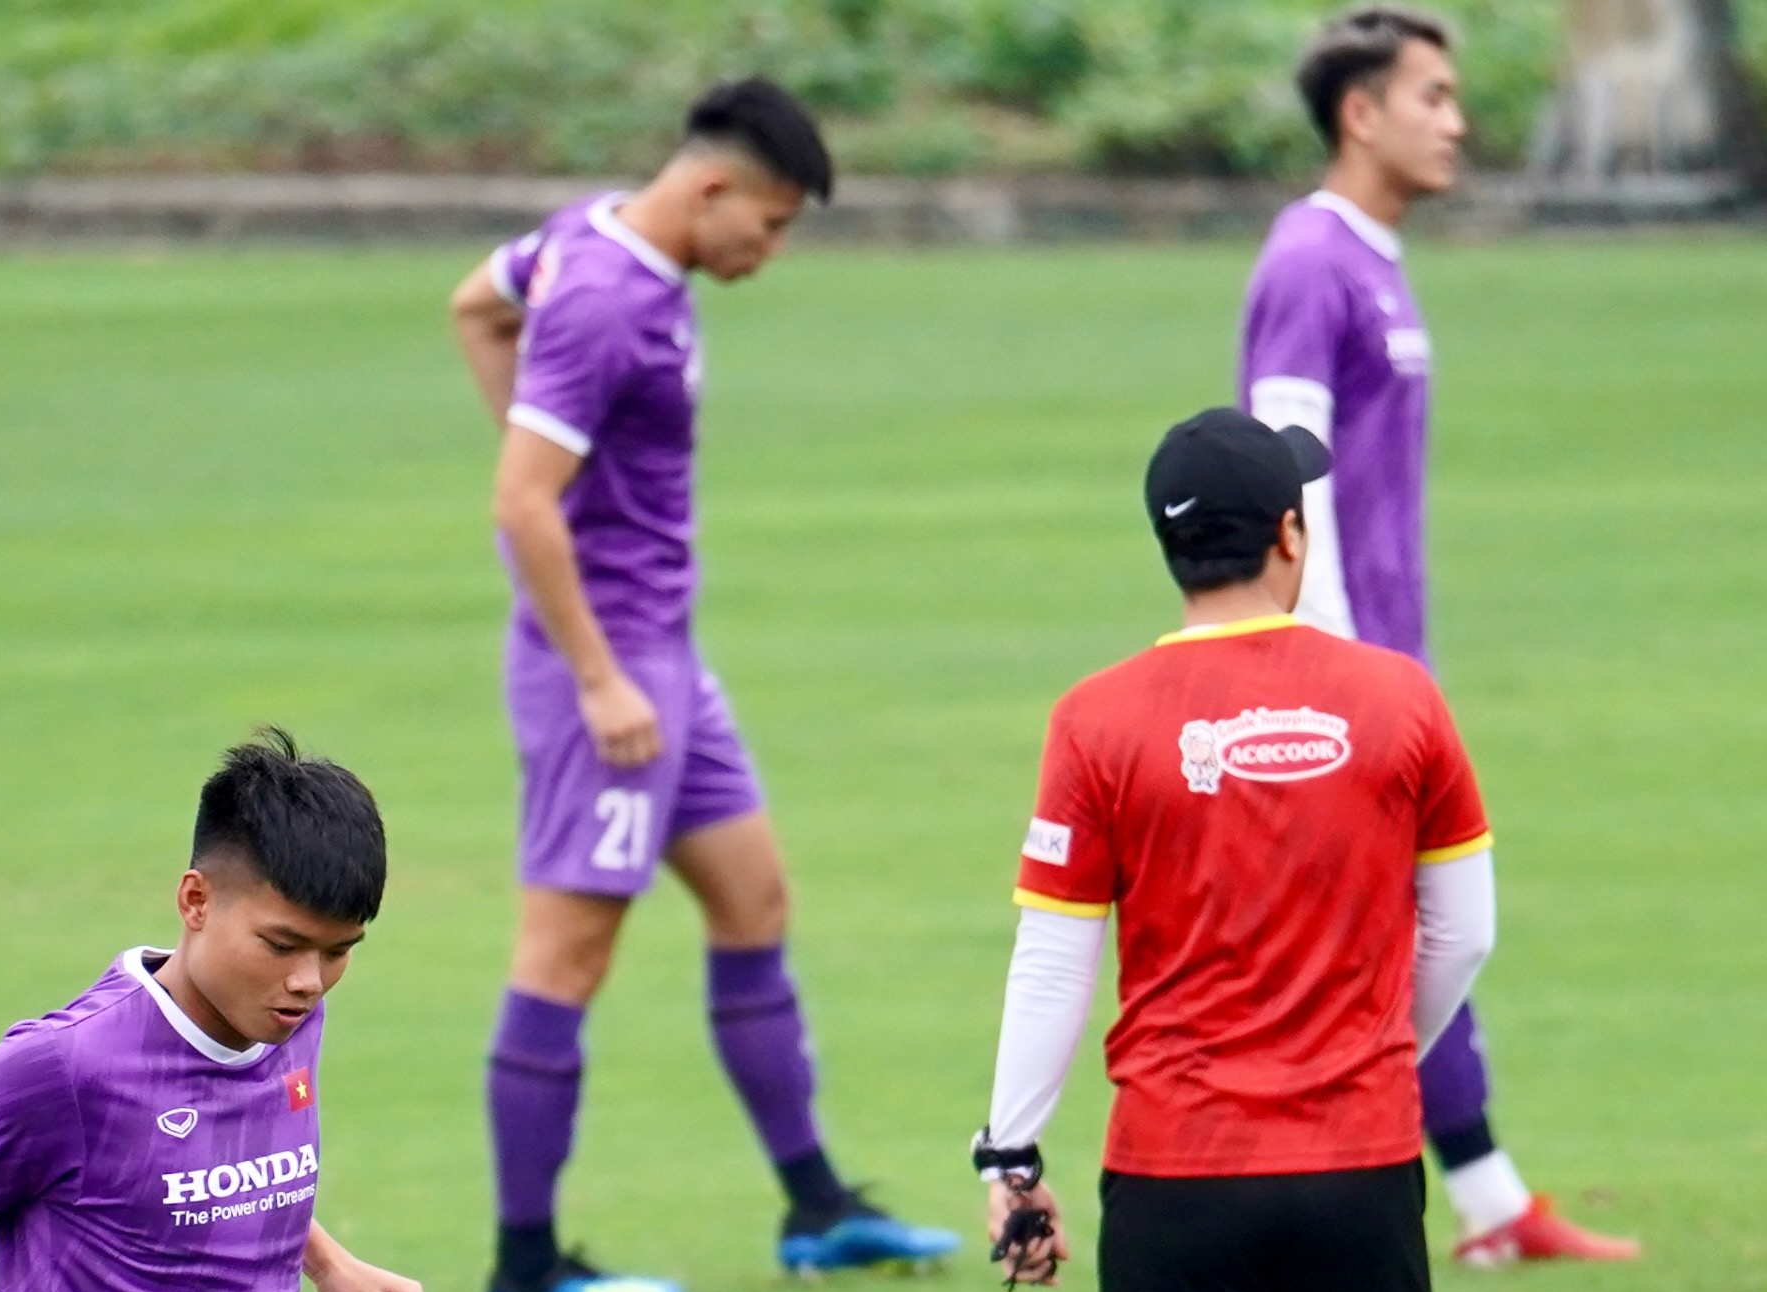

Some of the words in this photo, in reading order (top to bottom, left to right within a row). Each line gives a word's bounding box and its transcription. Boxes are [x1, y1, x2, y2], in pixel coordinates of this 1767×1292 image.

[591, 786, 653, 871] 21
[162, 1144, 319, 1205] HONDA
[171, 1210, 208, 1227] The
[211, 1200, 257, 1223] Power
[259, 1193, 274, 1212] of
[276, 1183, 316, 1208] Dreams
